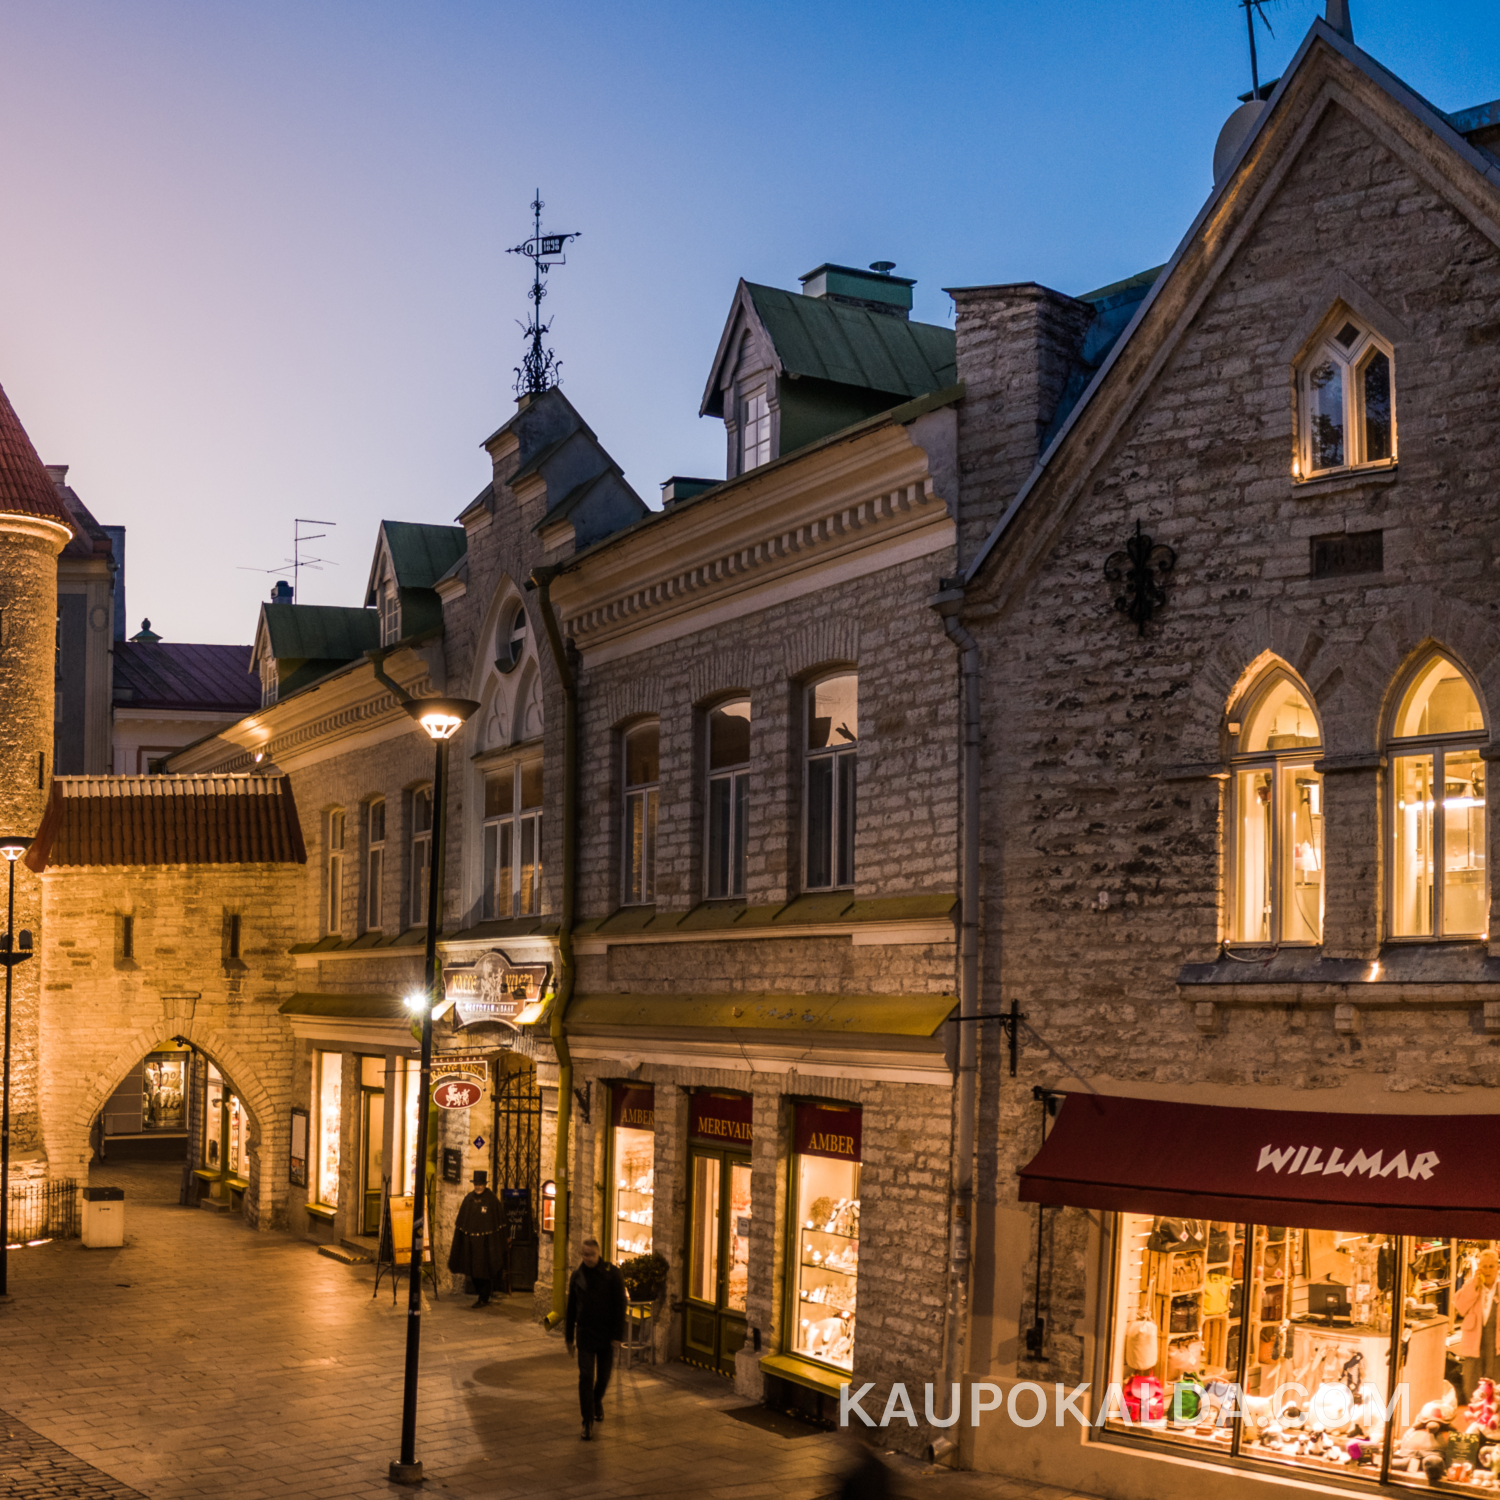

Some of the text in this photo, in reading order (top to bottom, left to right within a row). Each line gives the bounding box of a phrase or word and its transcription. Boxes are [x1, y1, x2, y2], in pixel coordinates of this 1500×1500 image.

[621, 1108, 654, 1125] AMBER
[808, 1132, 854, 1154] AMBER
[1256, 1143, 1441, 1180] WILLMAR
